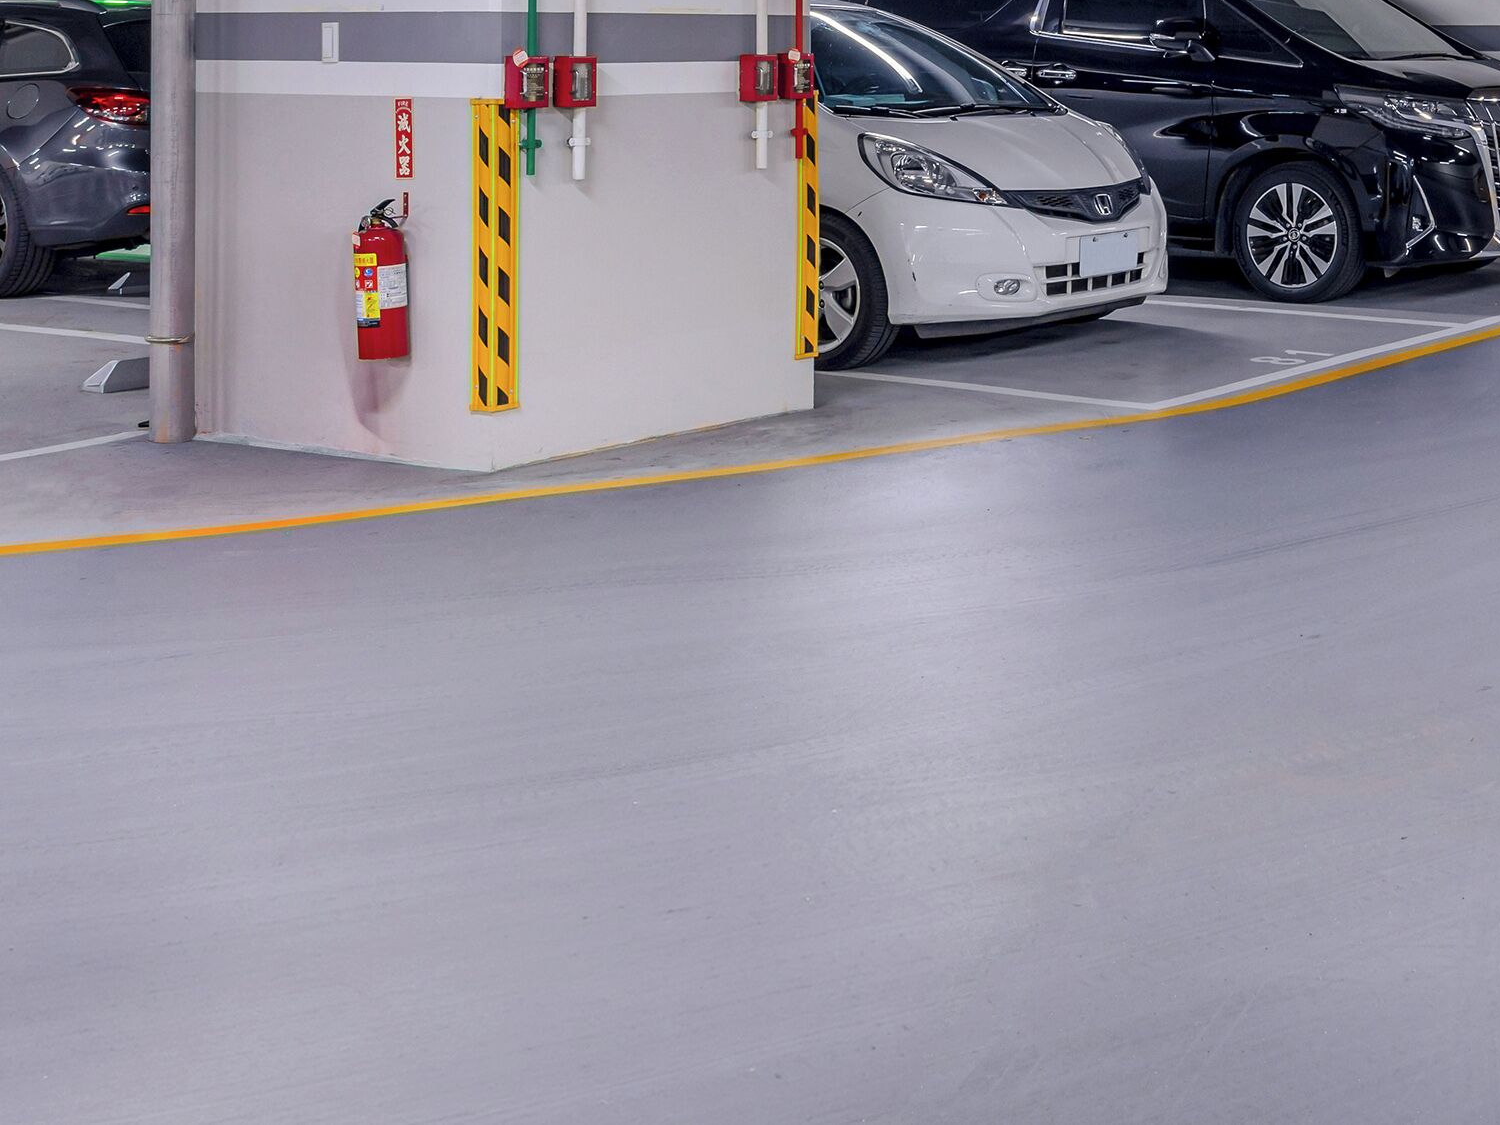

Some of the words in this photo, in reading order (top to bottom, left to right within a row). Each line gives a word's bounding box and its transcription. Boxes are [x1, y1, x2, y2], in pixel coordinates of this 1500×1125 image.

[397, 112, 411, 176] 滅火器
[1250, 350, 1335, 365] 81
